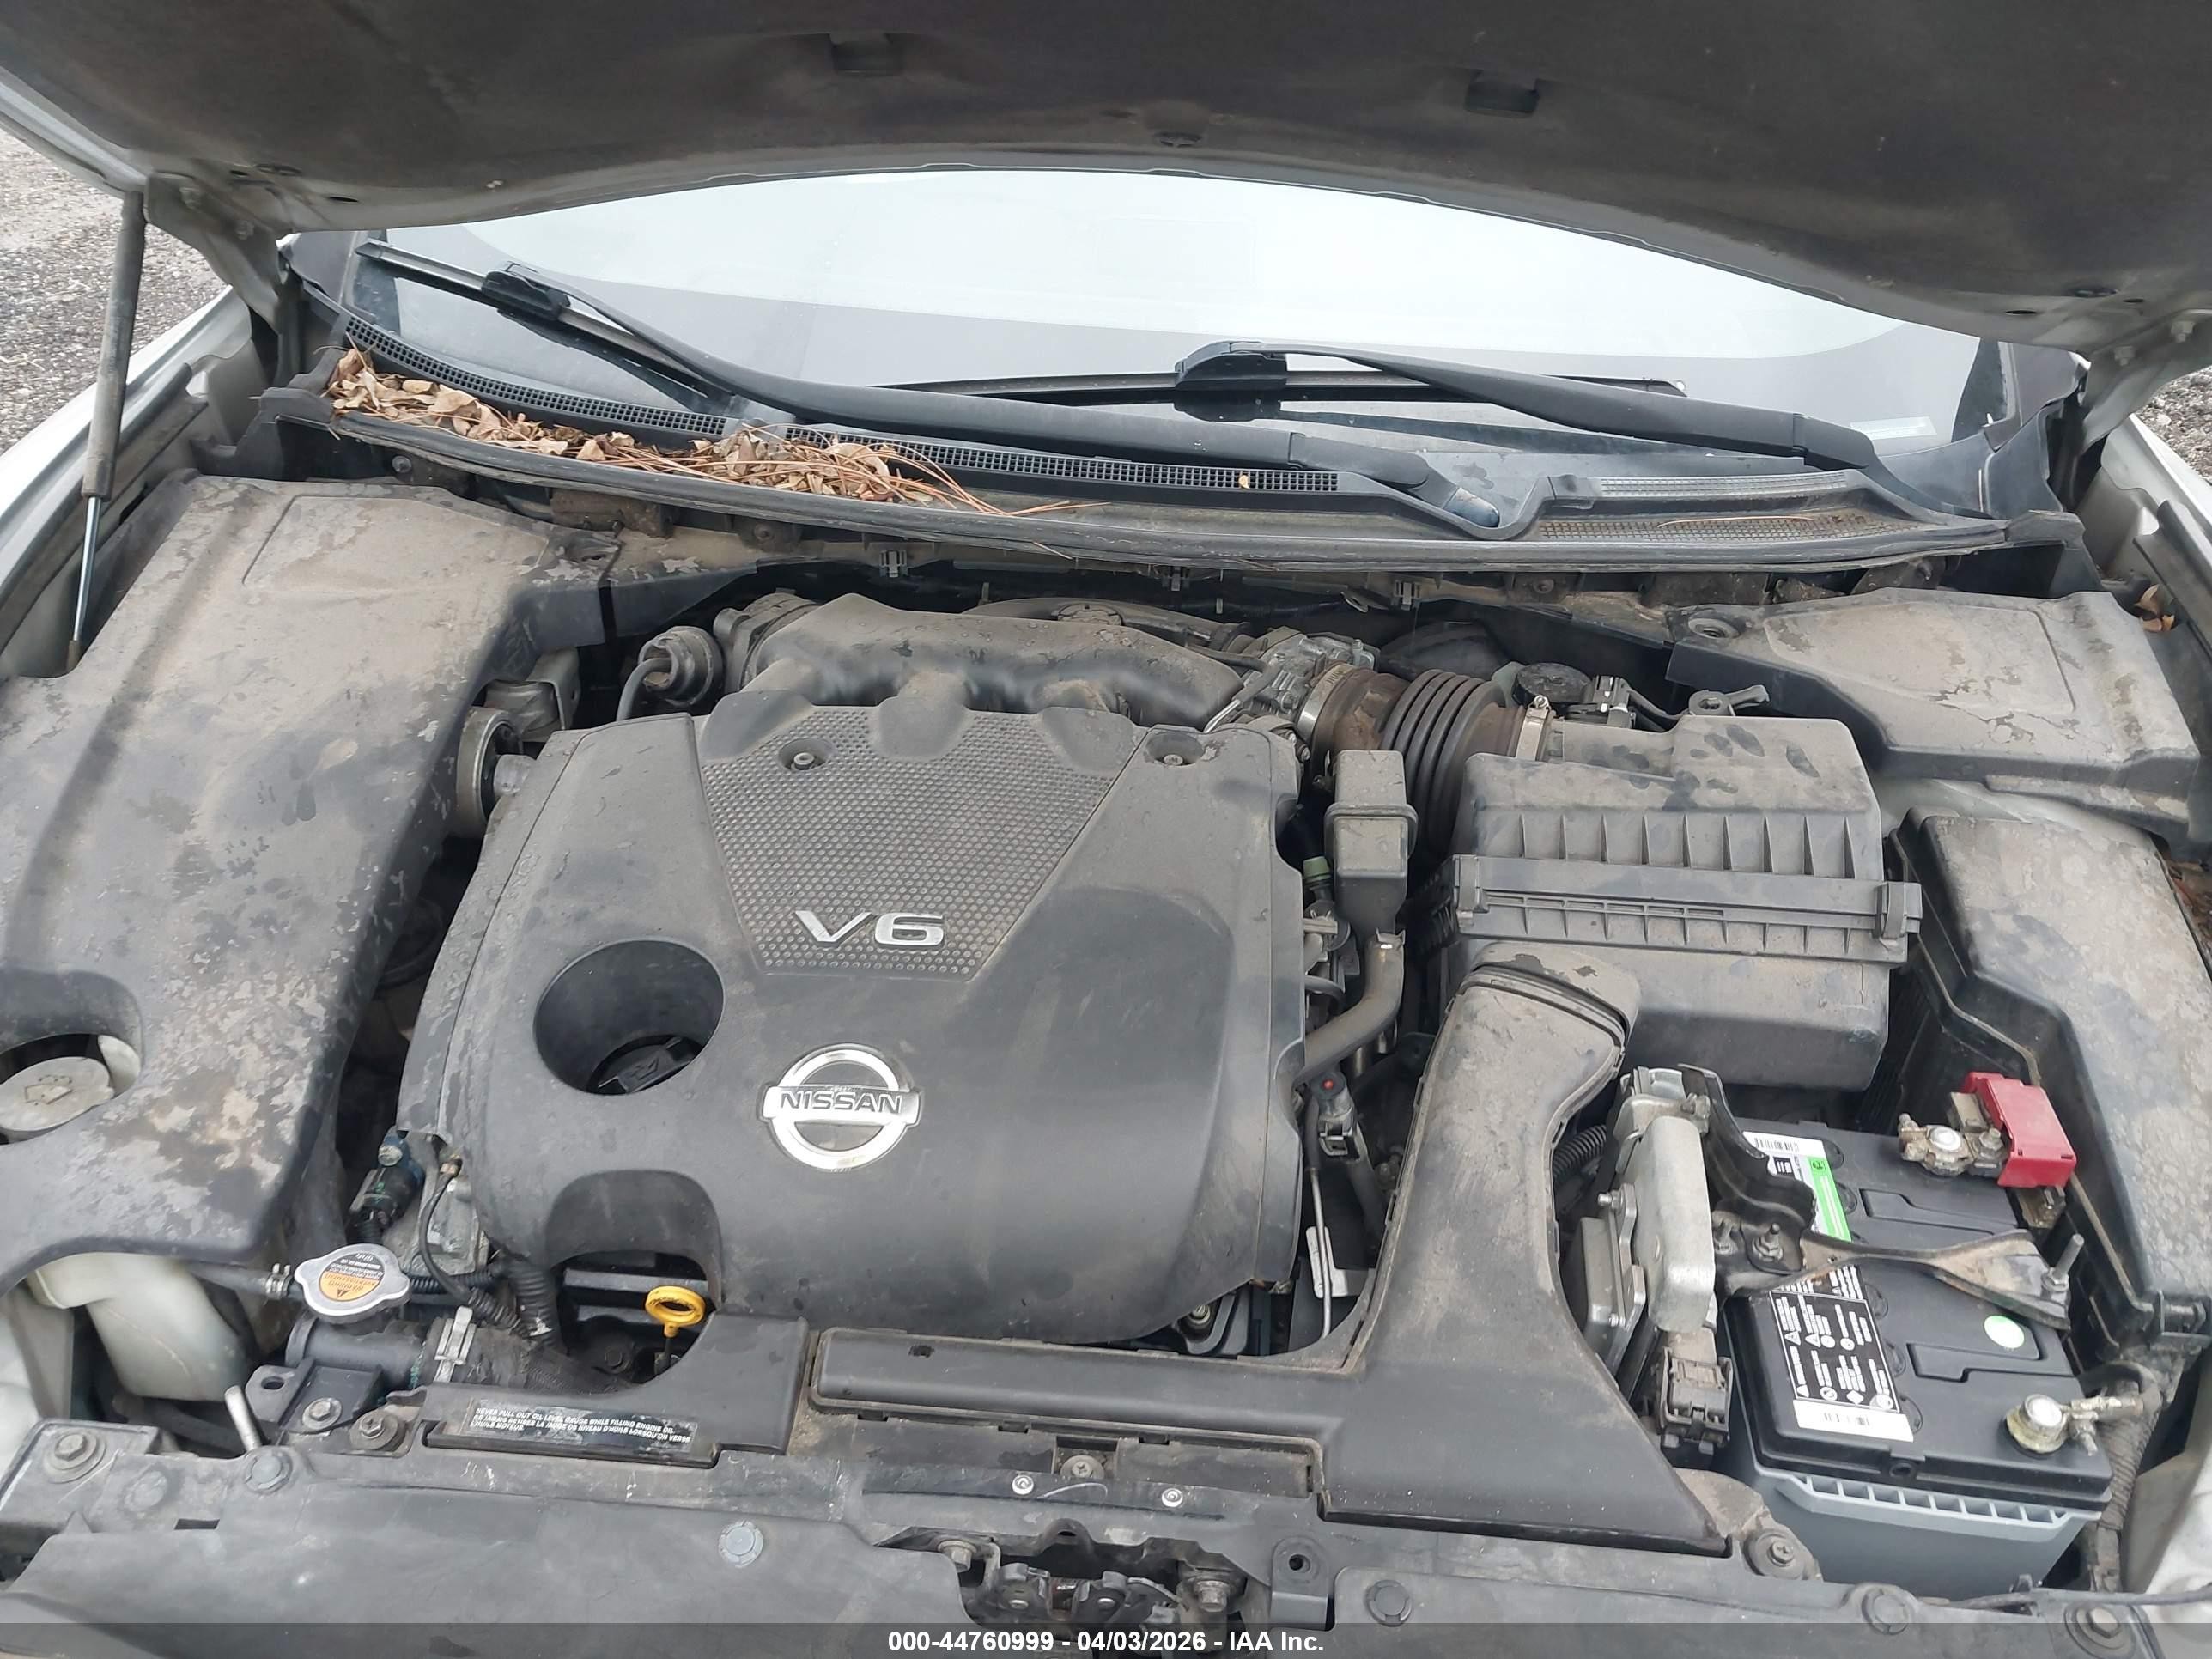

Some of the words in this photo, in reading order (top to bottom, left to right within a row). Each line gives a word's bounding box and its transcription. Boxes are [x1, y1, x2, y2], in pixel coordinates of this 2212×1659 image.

[794, 910, 945, 947] V6
[780, 1091, 902, 1114] NISSAN
[507, 1418, 536, 1426] RETIRER
[602, 1425, 629, 1434] D'HUILE
[668, 1434, 692, 1443] VERSE
[532, 1413, 544, 1421] OIL
[544, 1414, 564, 1423] LEVEL
[564, 1416, 589, 1425] GAUGE
[610, 1419, 635, 1428] FILLING
[635, 1422, 663, 1432] ENGINE
